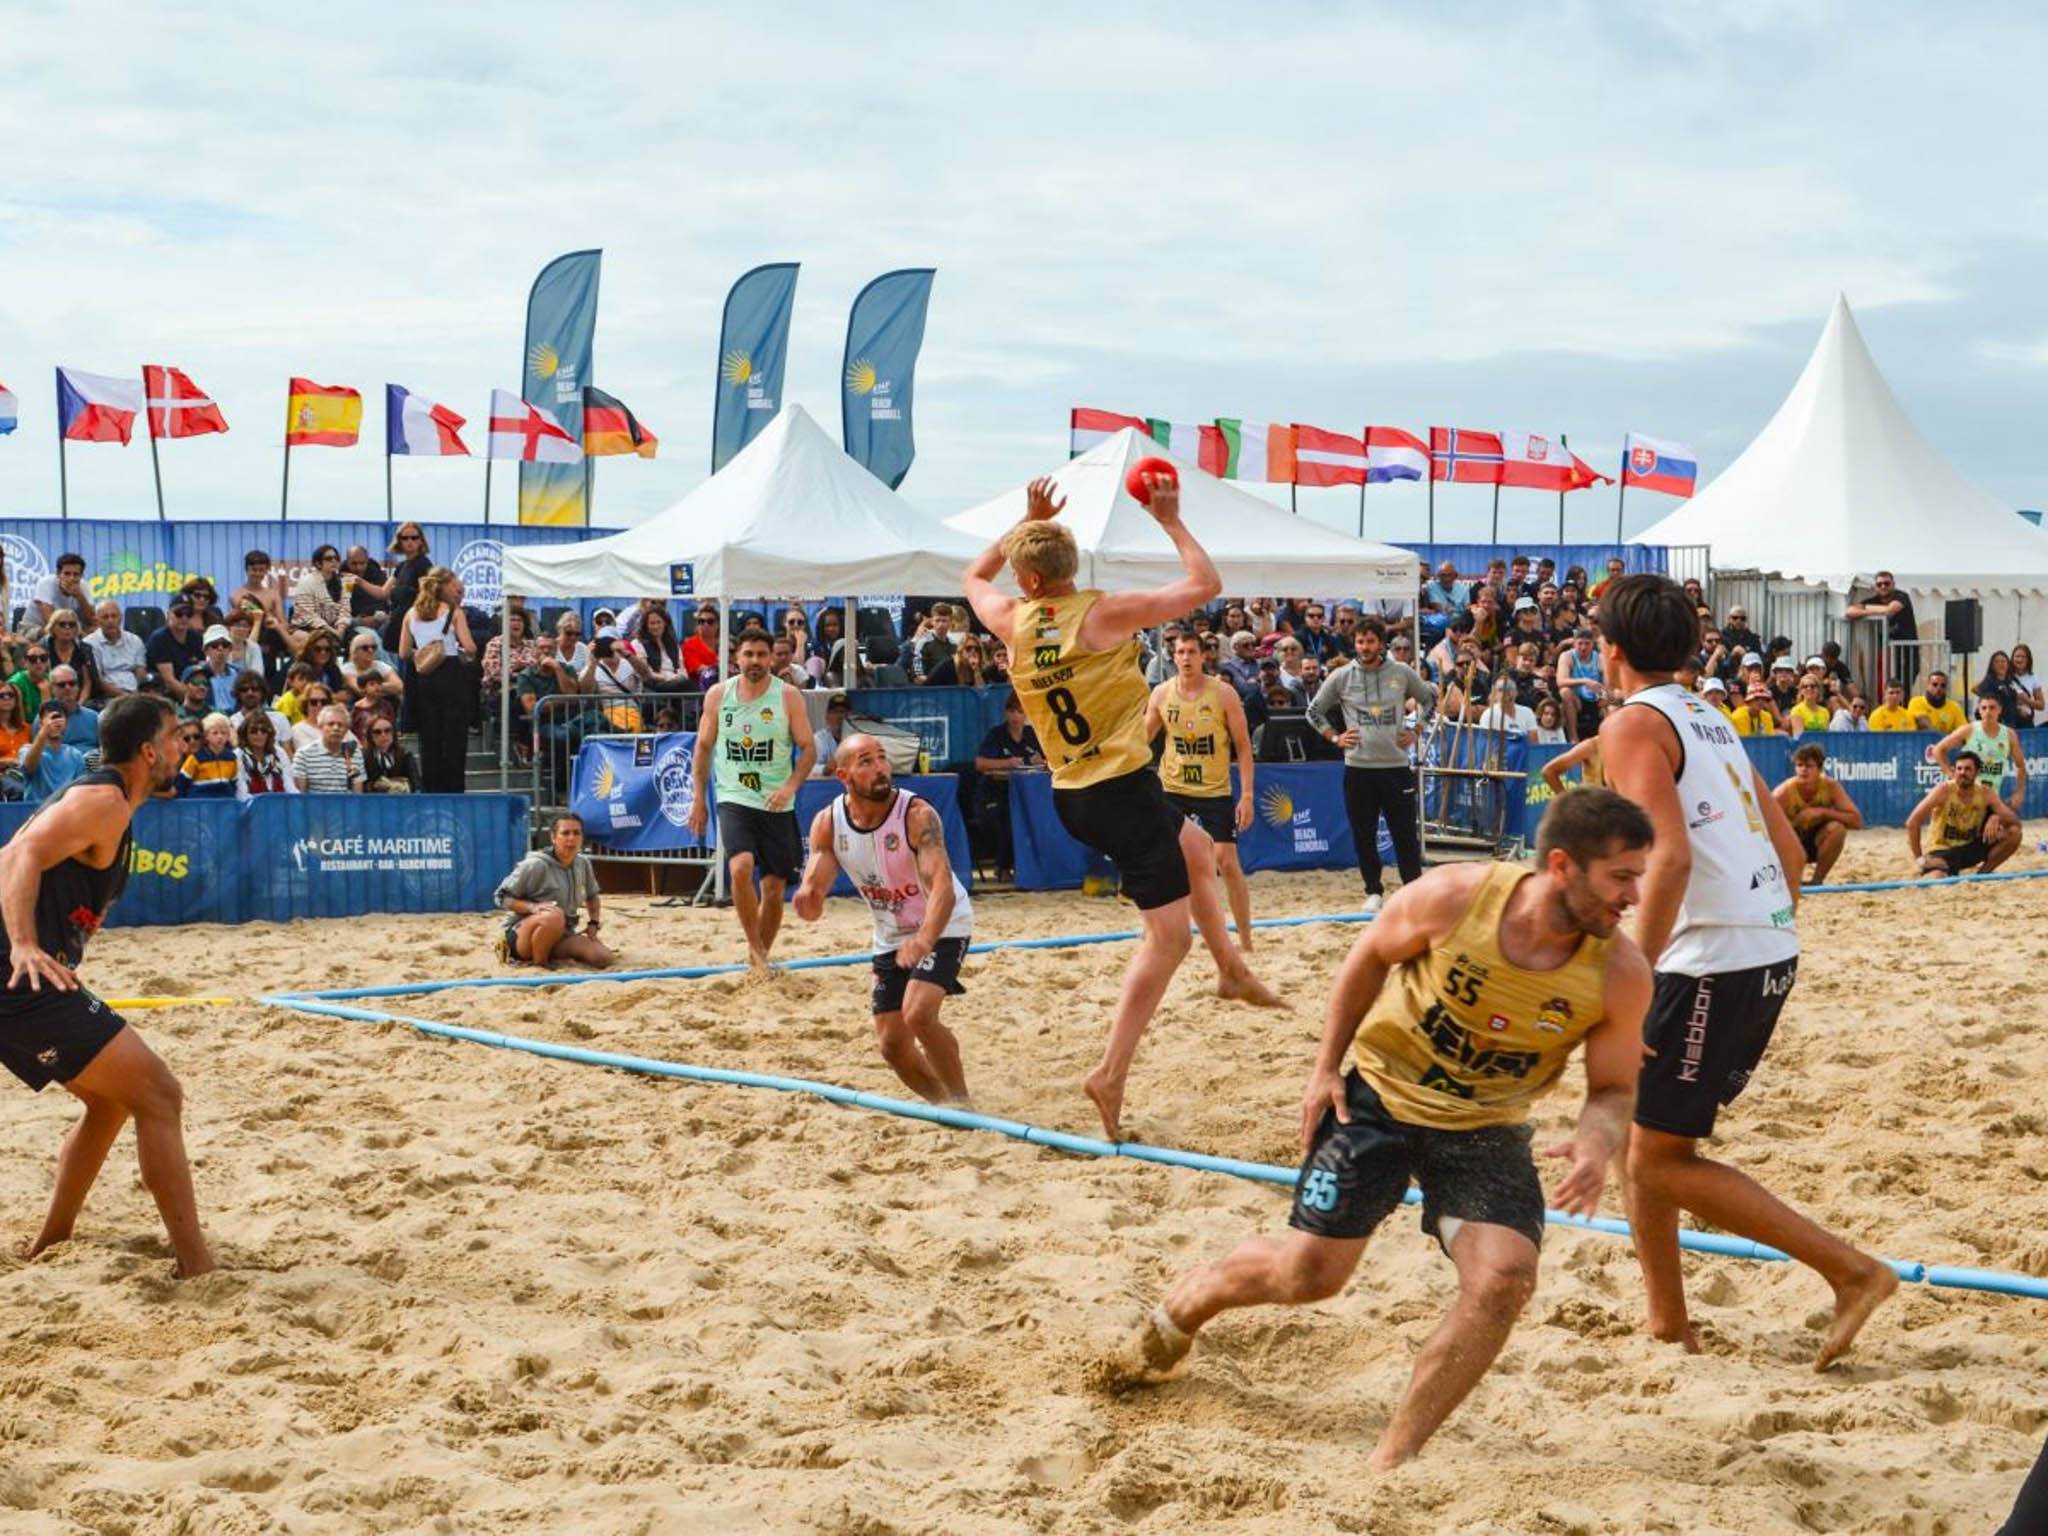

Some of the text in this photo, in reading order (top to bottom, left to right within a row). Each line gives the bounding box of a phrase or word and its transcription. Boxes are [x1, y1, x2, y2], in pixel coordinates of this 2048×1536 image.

[89, 561, 214, 598] CARAÏB
[725, 713, 733, 728] 9
[1046, 687, 1091, 746] 8
[1167, 709, 1179, 723] 77
[1833, 757, 1897, 781] hummel
[320, 834, 452, 855] CAFÉ MARITIME
[1443, 966, 1484, 1008] 55
[1302, 1168, 1338, 1211] 55
